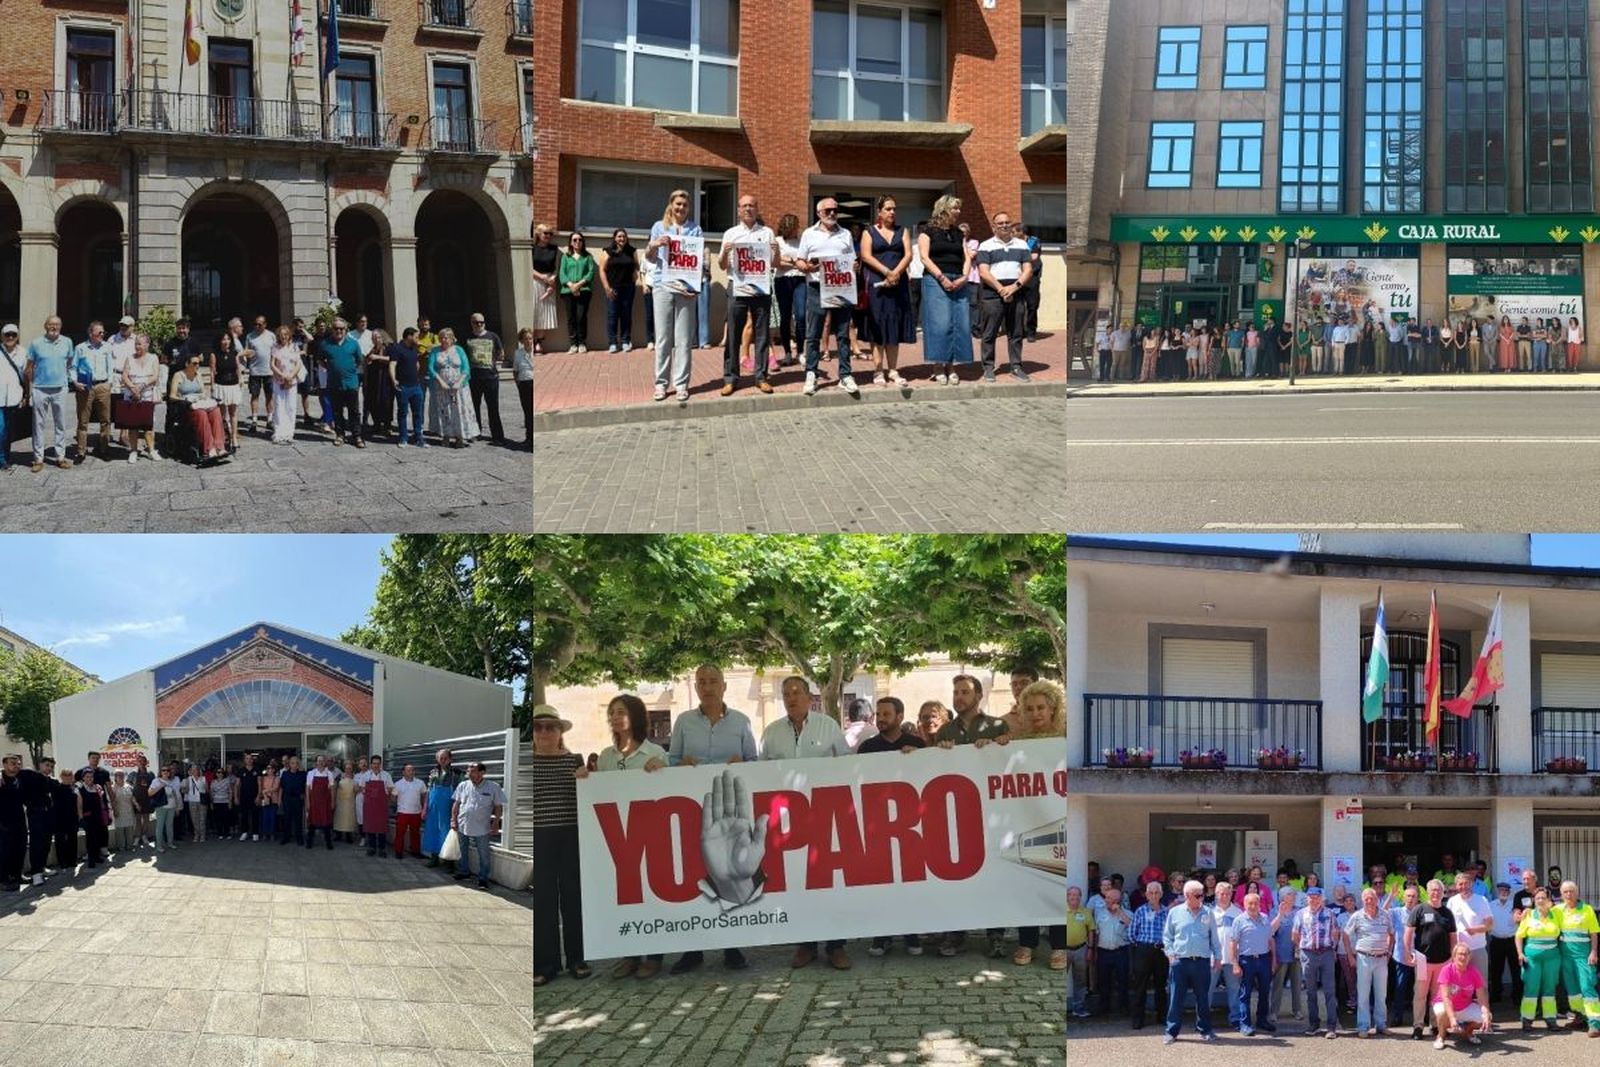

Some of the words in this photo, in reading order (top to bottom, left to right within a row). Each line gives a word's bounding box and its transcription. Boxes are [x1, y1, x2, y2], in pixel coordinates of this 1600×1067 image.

[1398, 225, 1439, 239] CAJA
[1443, 225, 1500, 239] RURAL
[668, 240, 681, 253] YO
[736, 247, 750, 259] YO
[668, 254, 698, 268] PARO
[738, 260, 766, 273] PARO
[822, 261, 836, 273] YO
[824, 272, 852, 285] PARO
[1365, 271, 1395, 282] Gente
[1380, 282, 1406, 291] como
[1390, 287, 1413, 308] tú
[1499, 302, 1529, 315] Gente
[1529, 306, 1557, 315] como
[1558, 298, 1577, 316] tú
[987, 771, 1048, 800] PARA
[593, 796, 705, 905] YO
[752, 774, 986, 893] PARO
[618, 911, 788, 936] #YoParoPorSanabria
